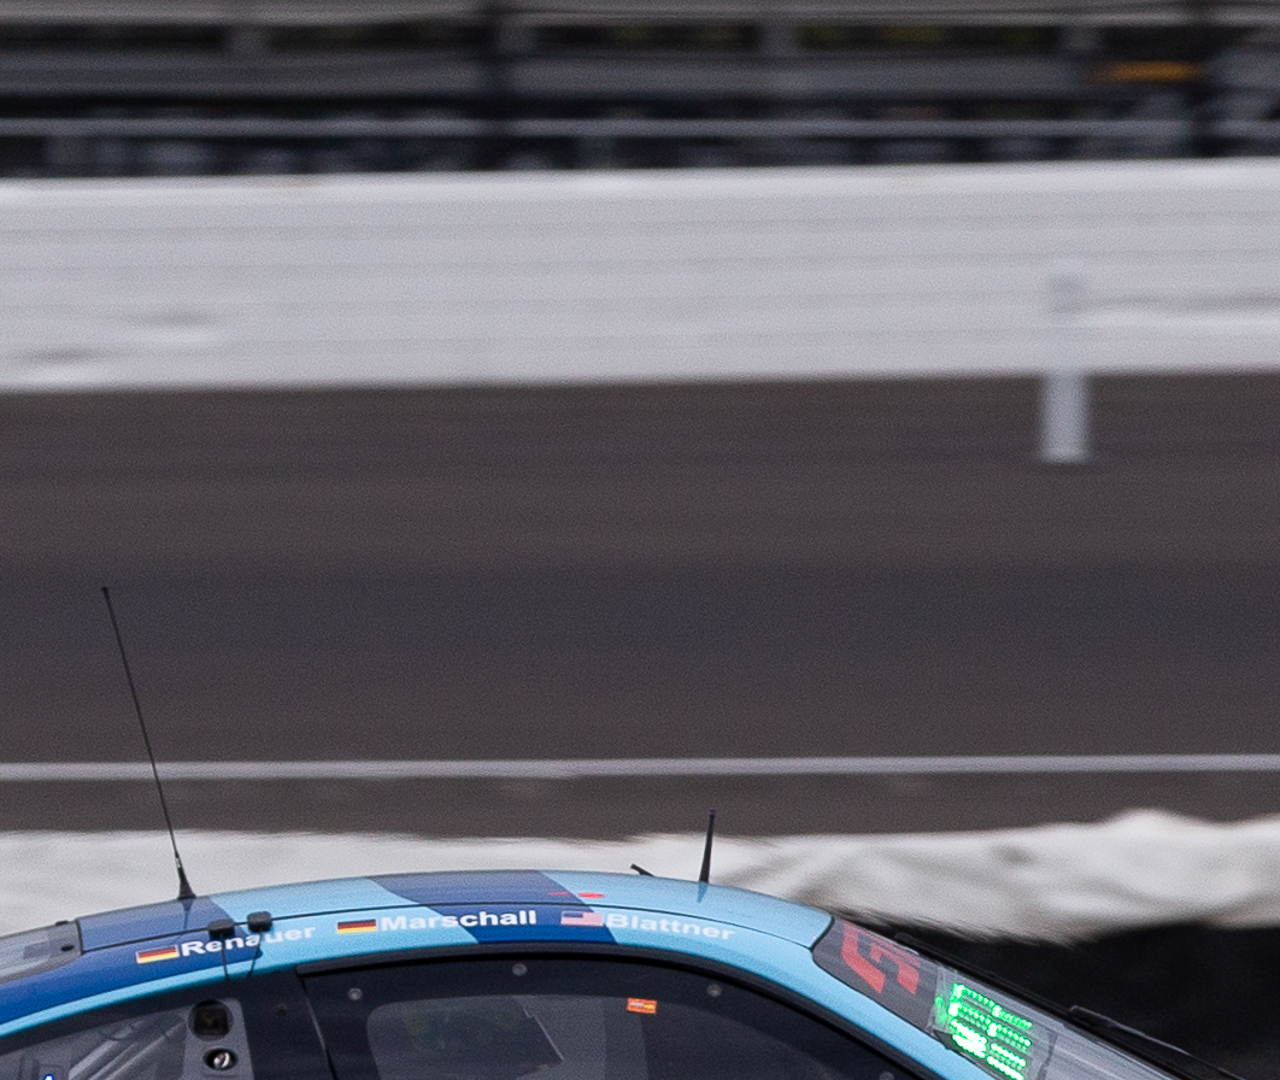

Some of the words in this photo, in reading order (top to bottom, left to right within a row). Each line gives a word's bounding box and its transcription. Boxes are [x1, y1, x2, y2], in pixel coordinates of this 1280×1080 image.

[380, 909, 537, 932] Marschall
[606, 912, 736, 940] Blattner
[180, 926, 317, 957] Renauer
